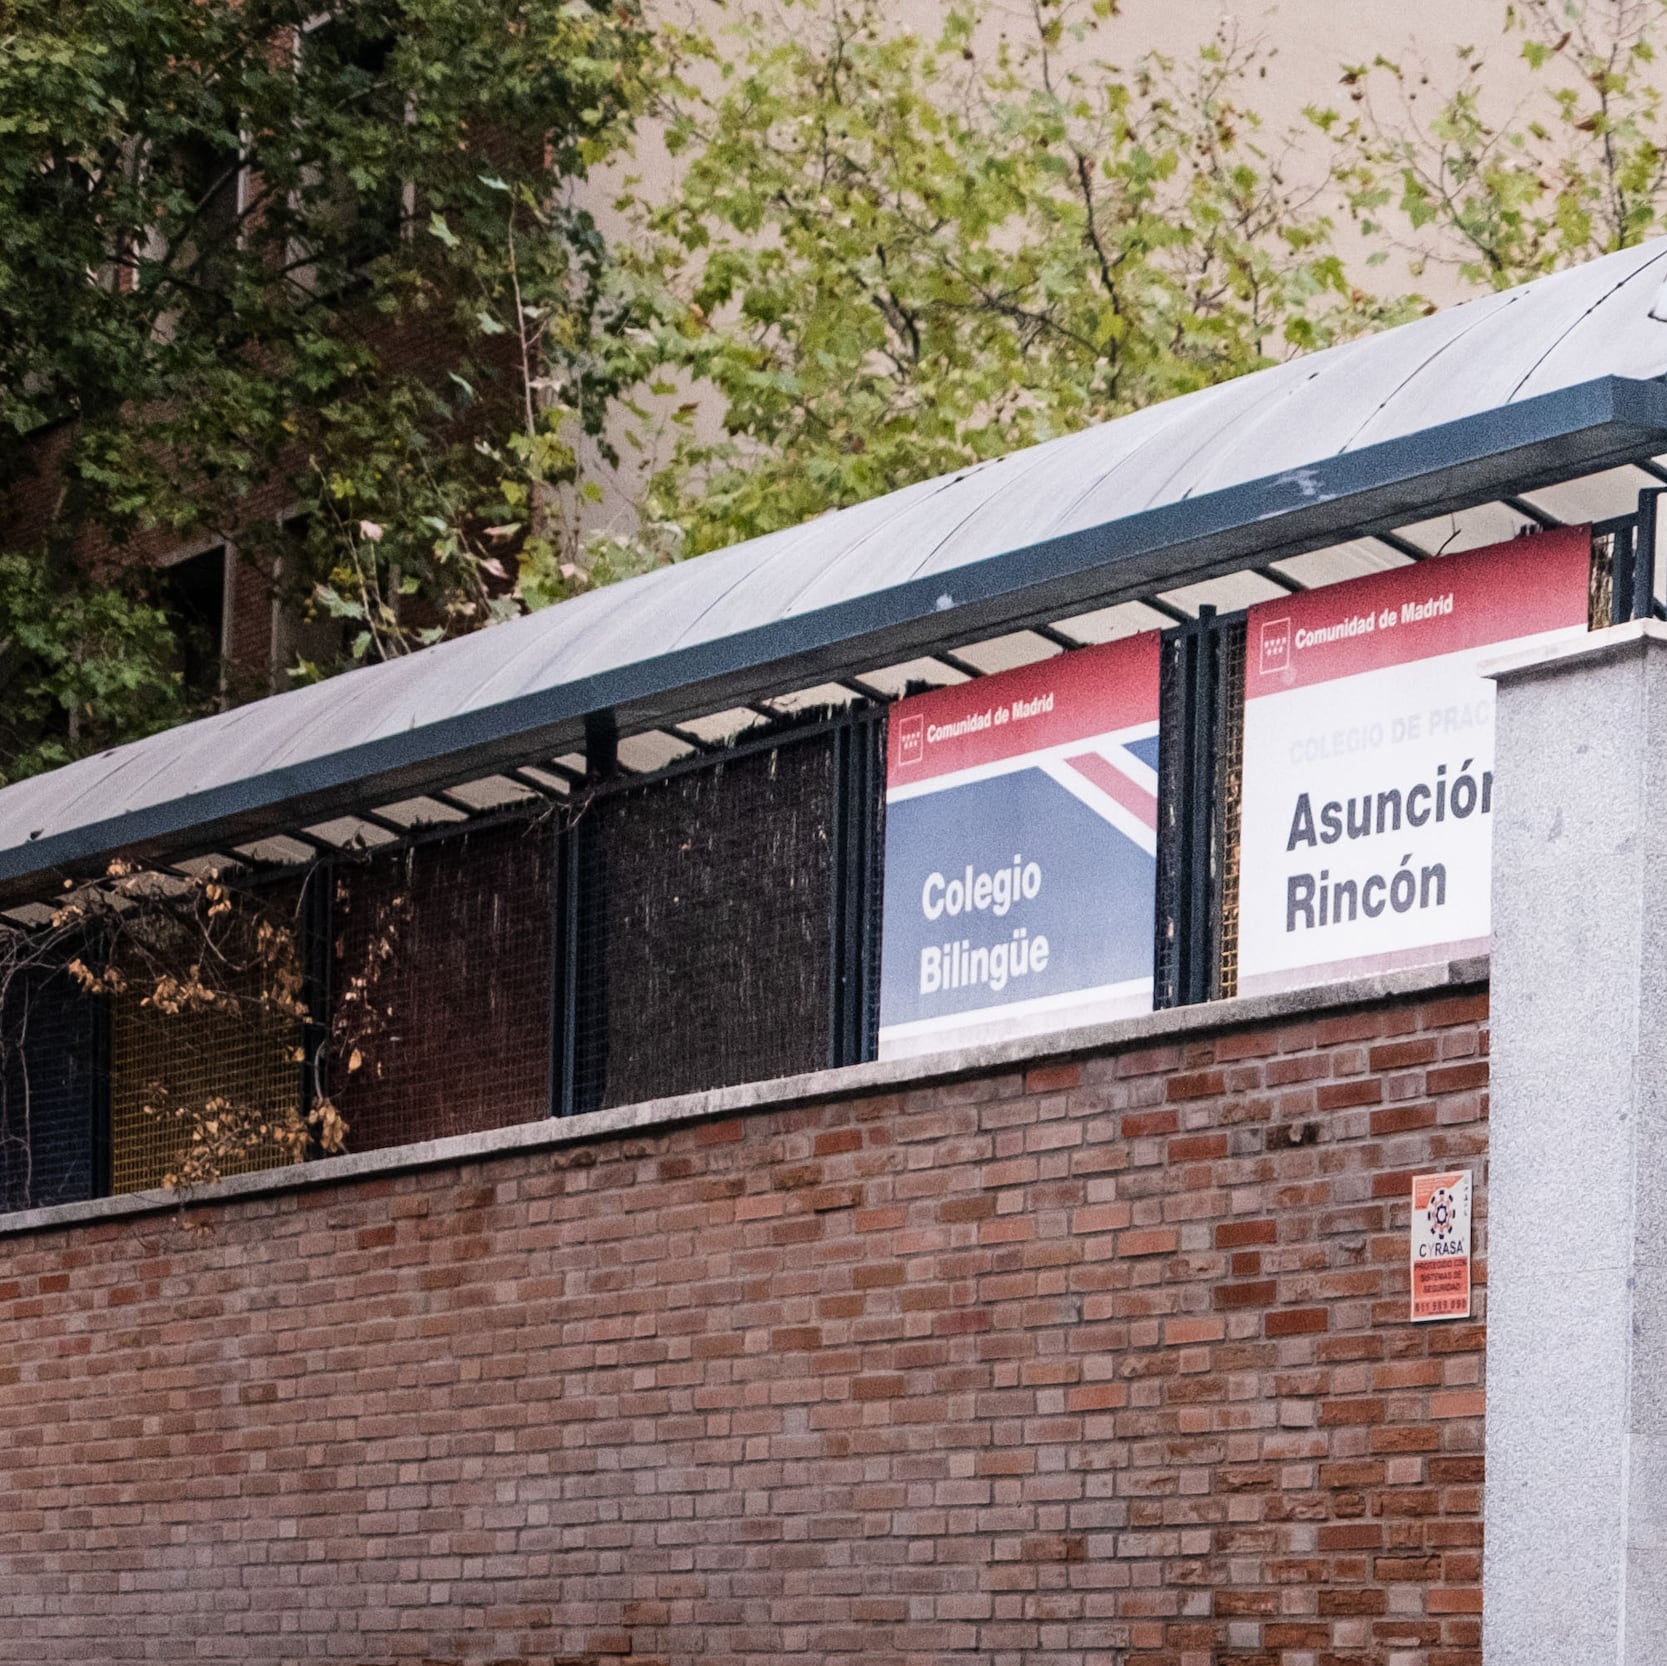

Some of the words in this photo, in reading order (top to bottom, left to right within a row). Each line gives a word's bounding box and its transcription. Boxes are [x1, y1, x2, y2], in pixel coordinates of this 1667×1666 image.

[1295, 615, 1374, 649] Comunidad
[1379, 610, 1397, 629] de
[1401, 593, 1454, 624] Madrid
[927, 708, 991, 743] Comunidad
[994, 706, 1009, 725] de
[1012, 692, 1054, 721] Madrid
[1390, 713, 1421, 745] DE
[922, 853, 1041, 921] Colegio
[1286, 853, 1446, 932] Rincón
[919, 927, 1050, 995] Bilingüe
